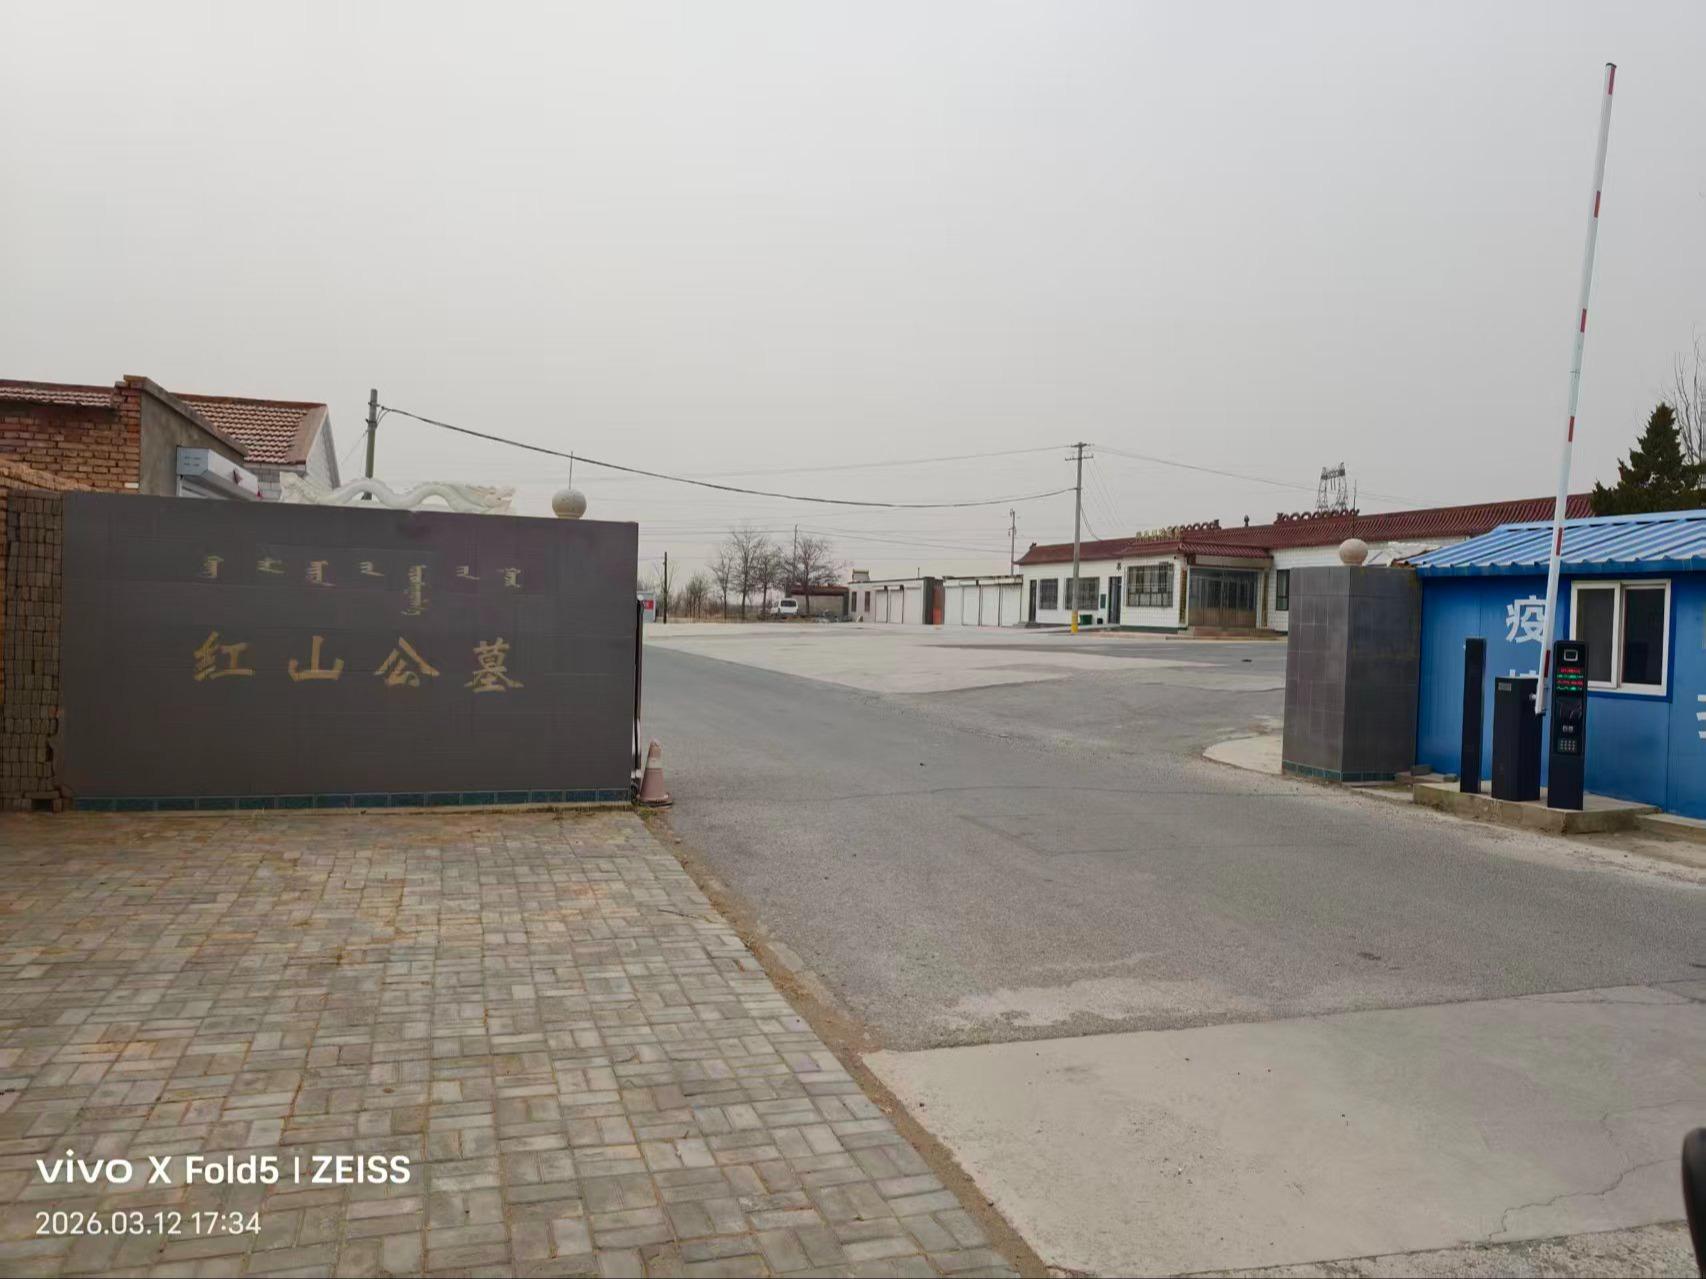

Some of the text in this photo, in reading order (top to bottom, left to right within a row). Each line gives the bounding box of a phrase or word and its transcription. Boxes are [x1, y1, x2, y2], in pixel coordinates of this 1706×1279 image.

[1505, 595, 1547, 644] 疫
[193, 631, 524, 693] 红山公墓
